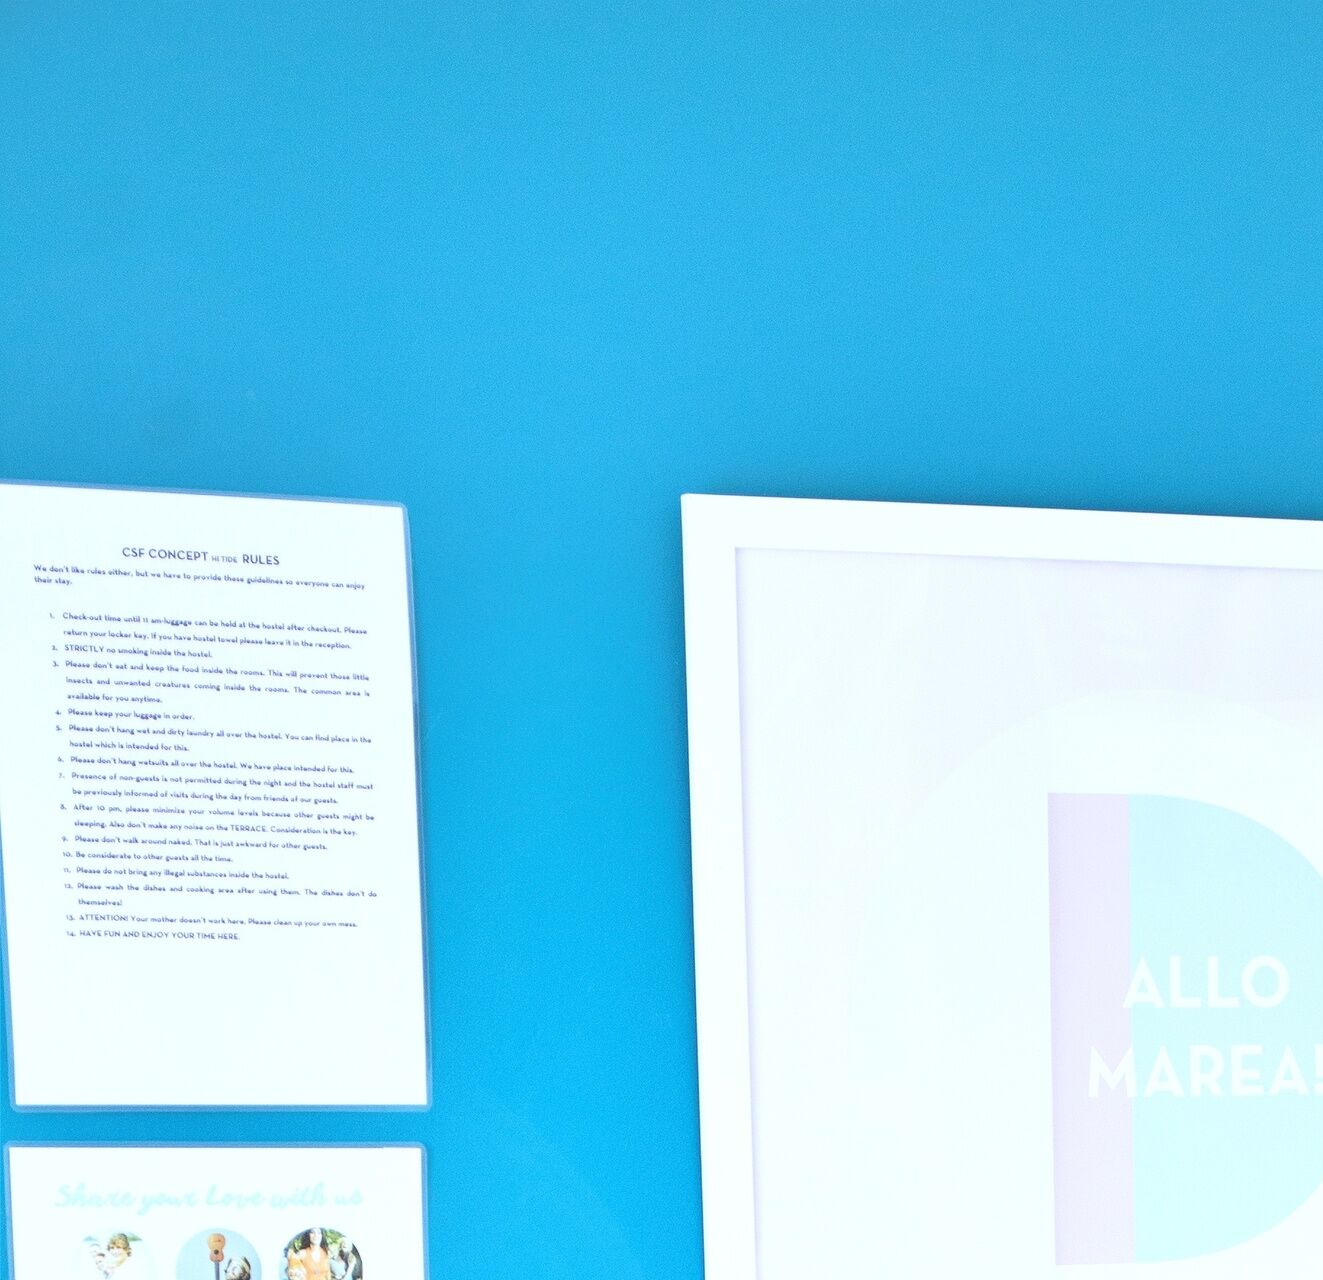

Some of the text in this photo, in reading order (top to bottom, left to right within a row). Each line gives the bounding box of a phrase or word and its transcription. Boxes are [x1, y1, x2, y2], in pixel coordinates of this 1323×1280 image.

[122, 547, 144, 557] CSF
[148, 548, 208, 561] CONCEPT
[242, 553, 280, 565] RULES
[33, 564, 48, 572] We
[49, 565, 69, 573] don't
[71, 566, 85, 574] like
[87, 567, 106, 575] rules
[107, 568, 133, 576] either,
[135, 569, 148, 577] but
[223, 574, 244, 582] these
[246, 576, 283, 584] guidelines
[346, 582, 364, 590] enjoy
[34, 575, 72, 586] their stay.
[62, 611, 102, 621] Check-out
[104, 614, 121, 622] time
[209, 619, 218, 627] be
[248, 621, 260, 629] the
[262, 622, 284, 630] hostel
[286, 623, 304, 631] after
[306, 625, 341, 633] checkout.
[344, 626, 367, 634] Please
[63, 628, 88, 636] return
[107, 630, 131, 638] locker
[133, 631, 149, 640] key.
[193, 634, 216, 642] hostel
[239, 637, 263, 645] please
[264, 637, 284, 645] leave
[315, 642, 351, 650] reception.
[64, 643, 104, 652] STRICTLY
[117, 647, 148, 656] smoking
[150, 648, 172, 656] inside
[187, 650, 212, 658] hostel.
[67, 708, 92, 716] Please
[94, 709, 113, 718] keep
[133, 710, 161, 720] luggage
[171, 931, 194, 939] YOUR
[217, 932, 240, 940] HERE.
[1123, 955, 1290, 1009] ALLO
[53, 1182, 135, 1208] Share
[138, 1191, 199, 1216] your
[270, 1182, 326, 1209] with
[333, 1189, 363, 1206] us
